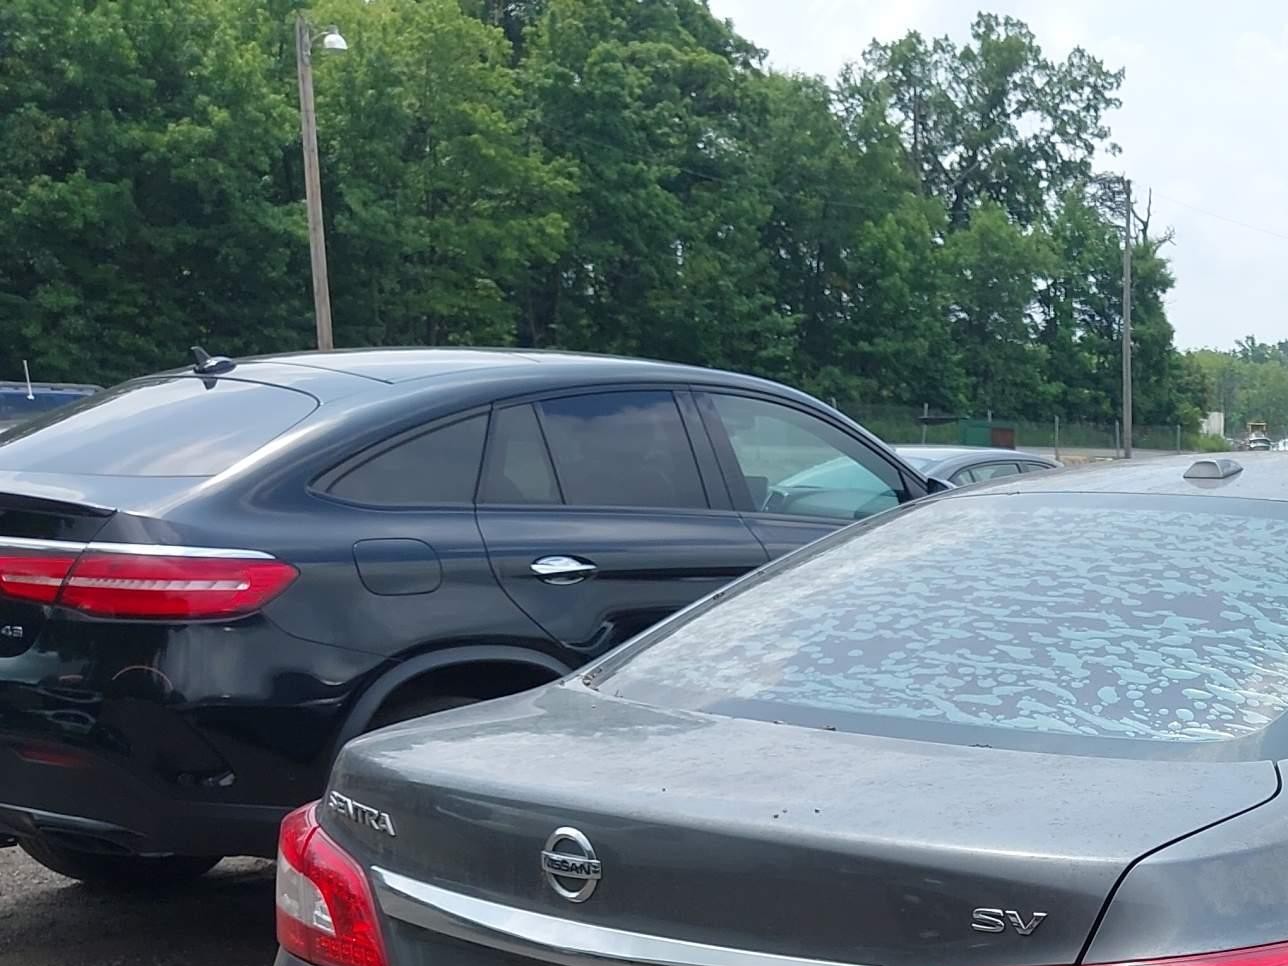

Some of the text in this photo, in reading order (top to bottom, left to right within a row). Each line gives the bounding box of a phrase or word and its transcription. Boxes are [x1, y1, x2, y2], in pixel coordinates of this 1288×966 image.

[0, 625, 24, 638] 43
[328, 790, 397, 836] SENTRA
[543, 856, 592, 875] NISSAN
[971, 907, 1048, 935] SV
